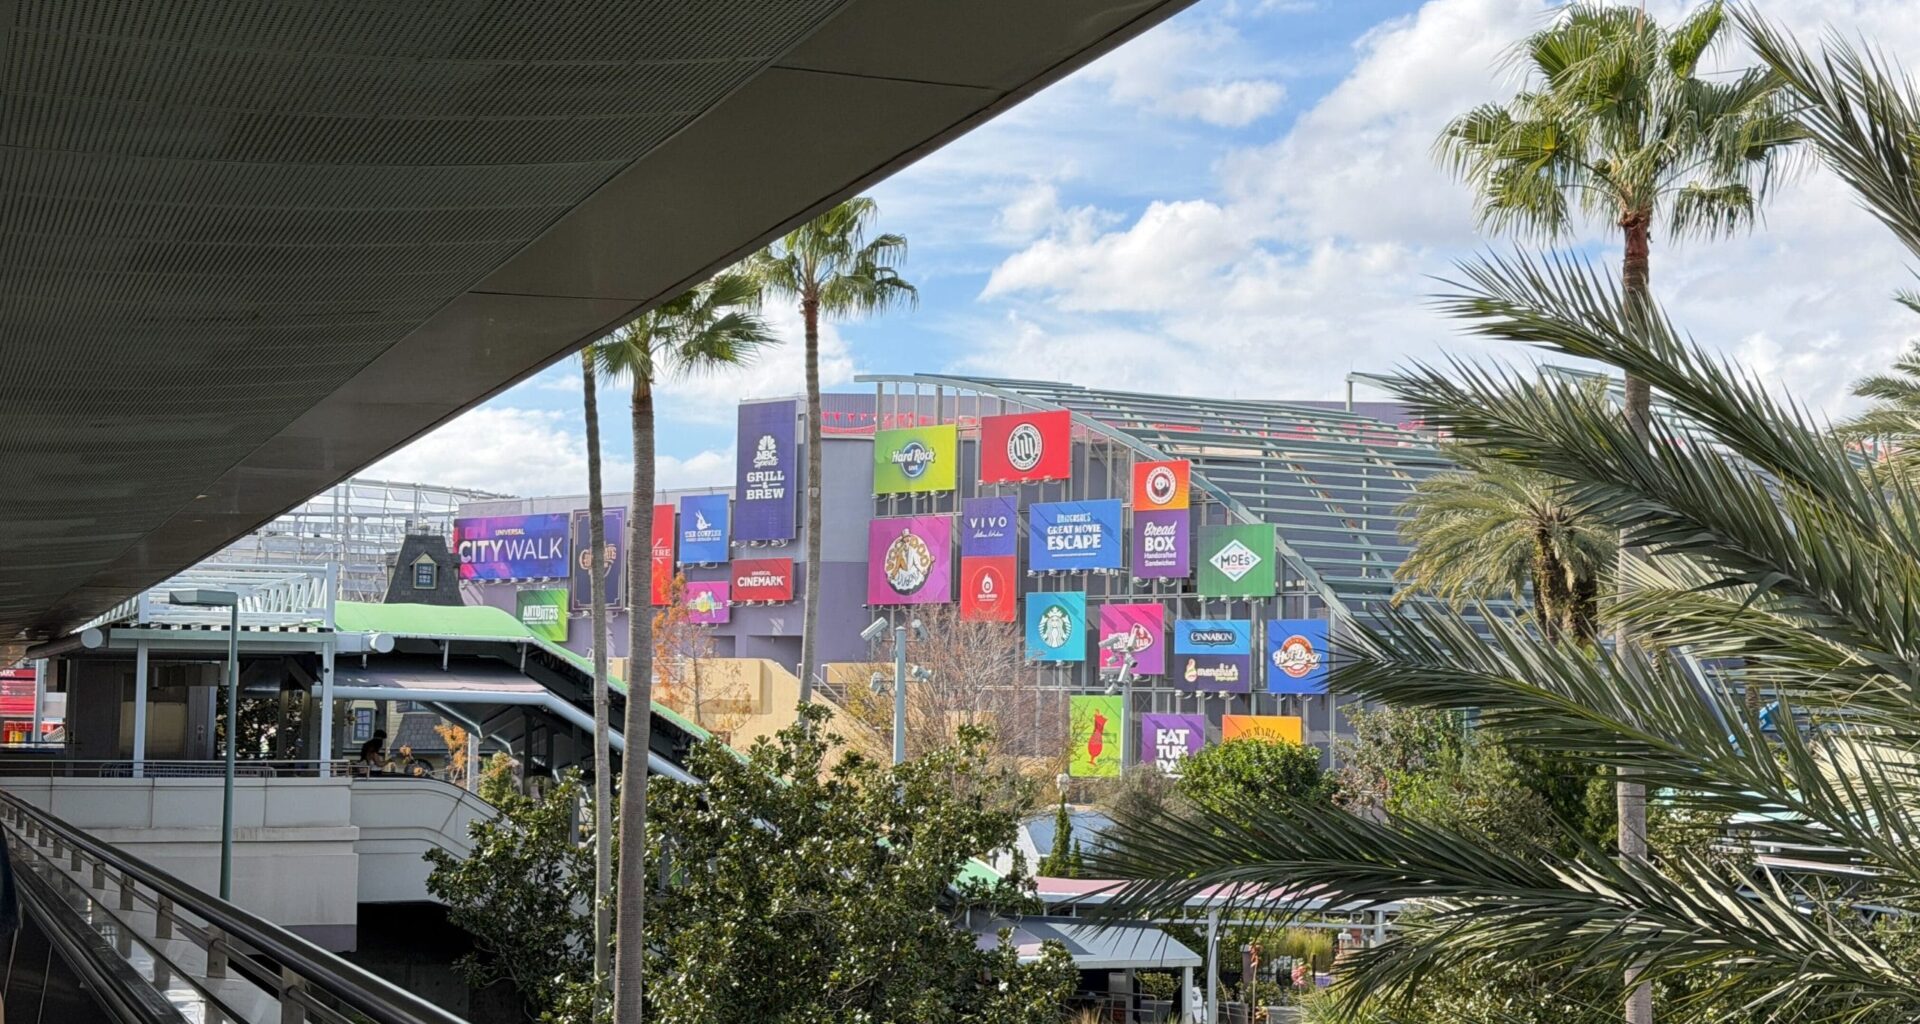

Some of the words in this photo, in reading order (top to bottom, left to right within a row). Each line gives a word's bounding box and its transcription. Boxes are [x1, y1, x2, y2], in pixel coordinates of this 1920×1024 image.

[757, 450, 776, 460] NBC
[892, 449, 913, 464] Hard
[914, 448, 936, 463] Rock
[746, 470, 785, 483] GRILL
[746, 488, 785, 500] BREW
[970, 516, 1007, 528] VIVO
[1144, 520, 1177, 536] Bread
[495, 528, 525, 536] UNIVERSAL
[1047, 524, 1073, 535] GREAT
[1074, 524, 1102, 534] MOVIE
[1047, 533, 1101, 550] ESCAPE
[1145, 536, 1176, 551] BOX
[737, 576, 784, 587] CINEMARK
[1190, 632, 1233, 642] CINNABON
[1156, 729, 1189, 745] FAT
